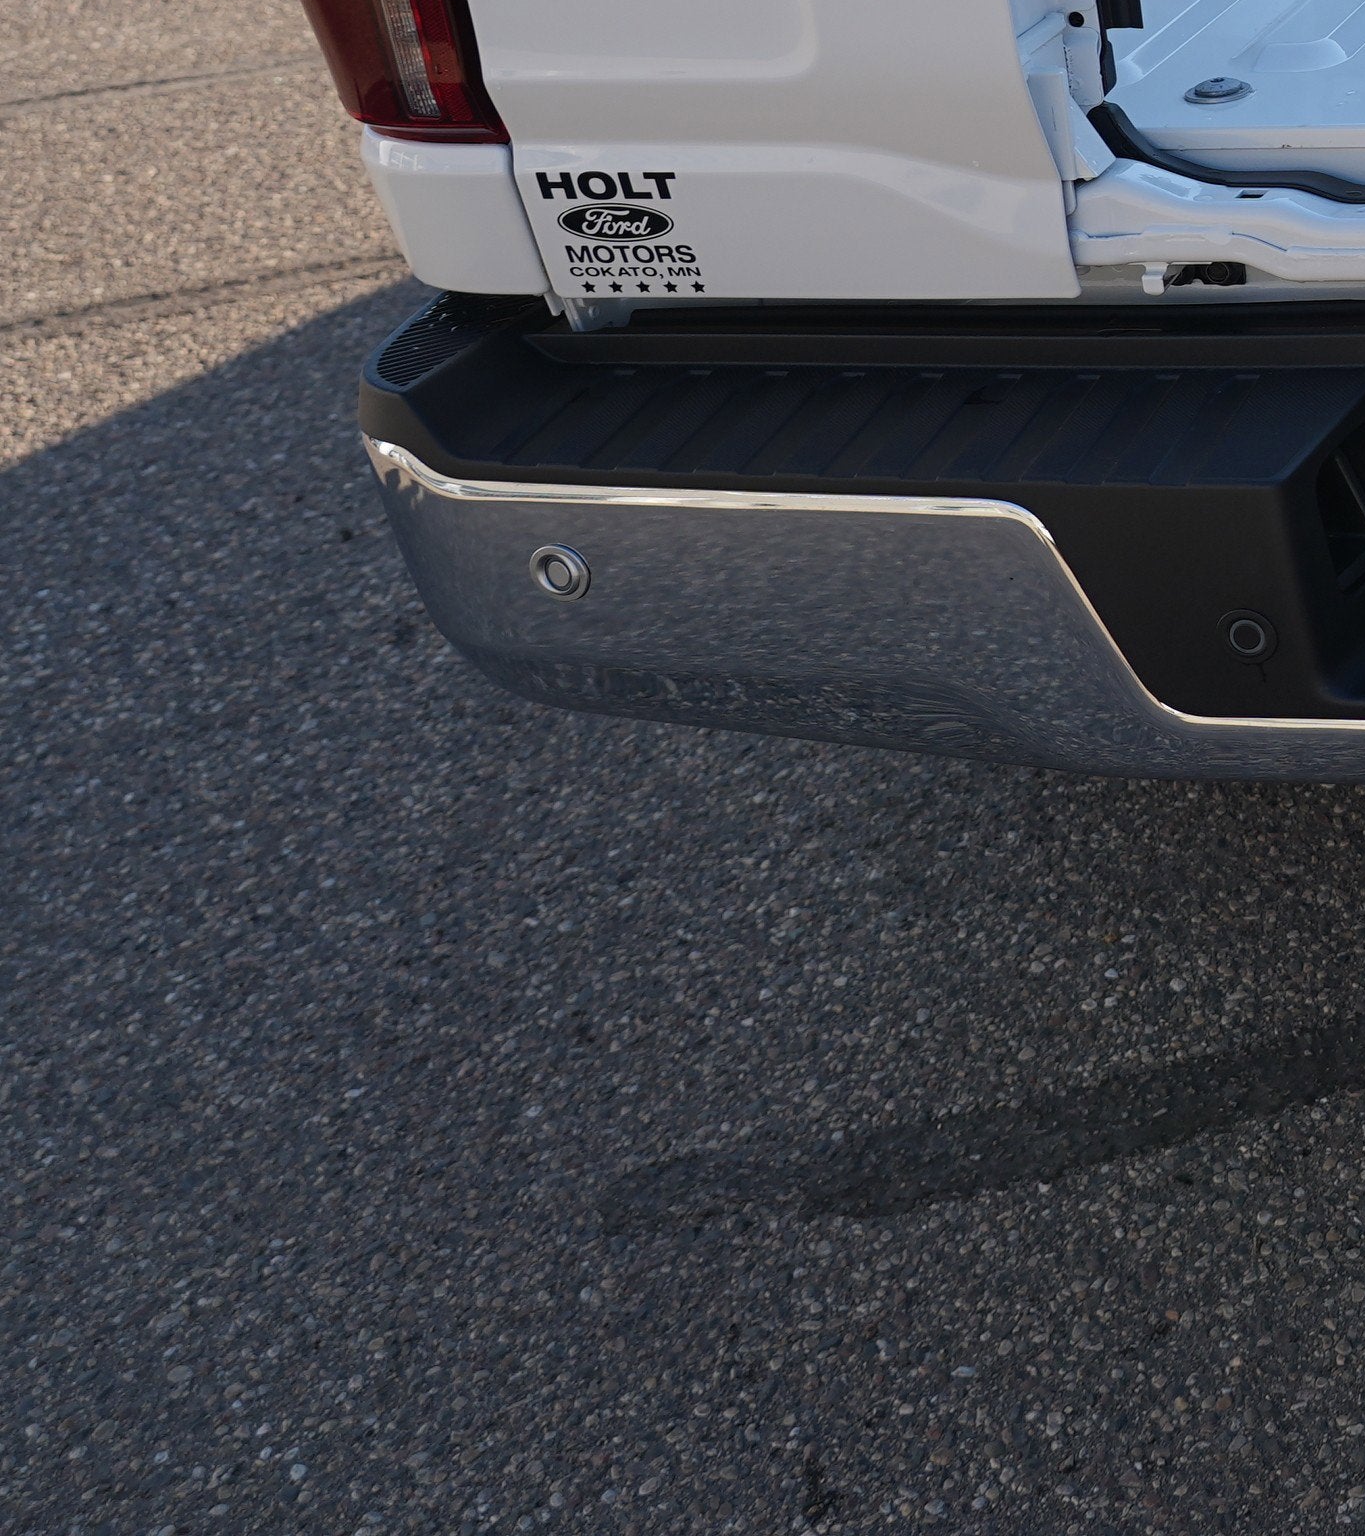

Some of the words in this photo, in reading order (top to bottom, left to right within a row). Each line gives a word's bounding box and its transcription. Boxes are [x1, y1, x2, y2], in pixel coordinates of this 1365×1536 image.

[535, 171, 676, 200] HOLT
[581, 208, 651, 235] Ford
[564, 245, 697, 264] MOTORS
[569, 267, 664, 279] COKATO,
[668, 267, 702, 277] MN
